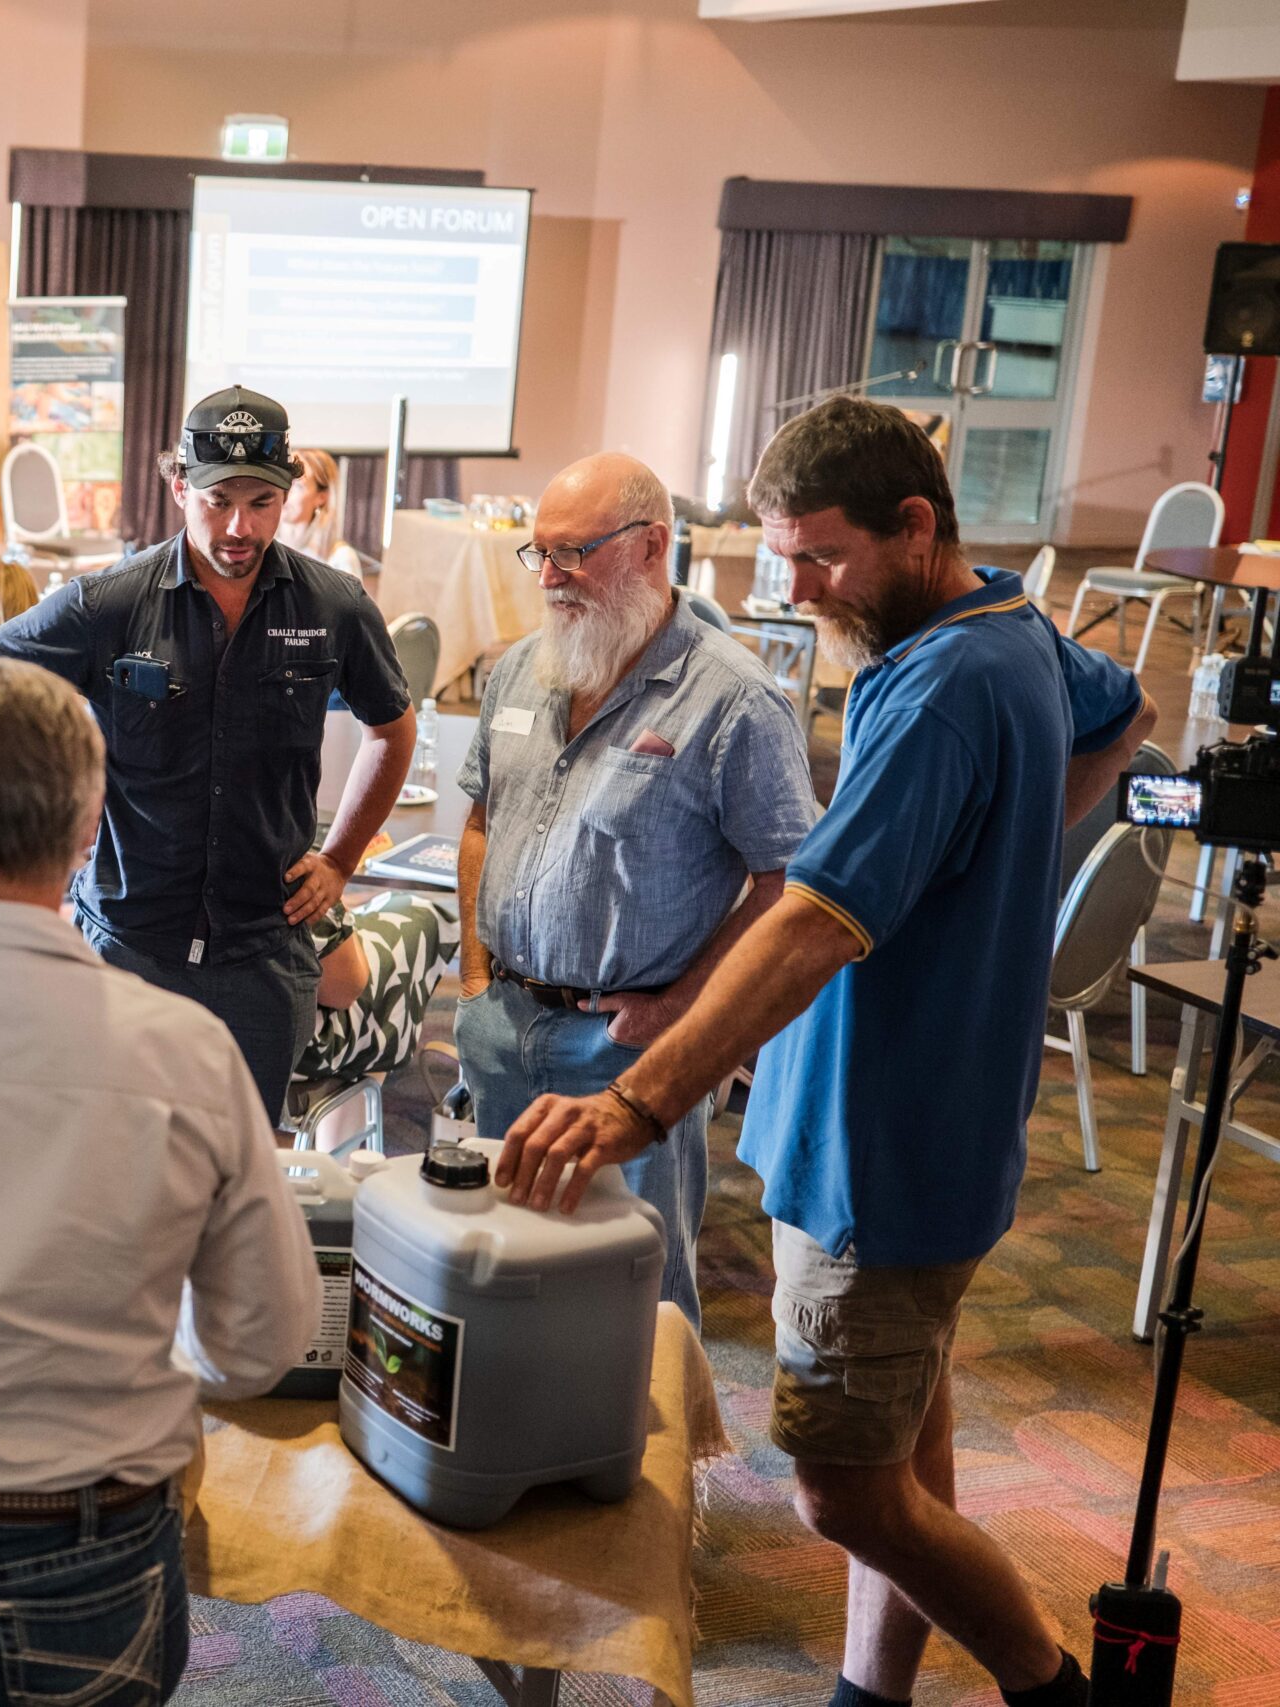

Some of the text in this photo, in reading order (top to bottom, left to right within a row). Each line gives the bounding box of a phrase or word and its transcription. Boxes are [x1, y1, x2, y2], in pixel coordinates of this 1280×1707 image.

[360, 205, 515, 234] OPEN FORUM
[267, 628, 327, 637] CHALLY BRIDGE
[284, 638, 310, 646] FARMS
[354, 1268, 444, 1342] WORMWORKS
